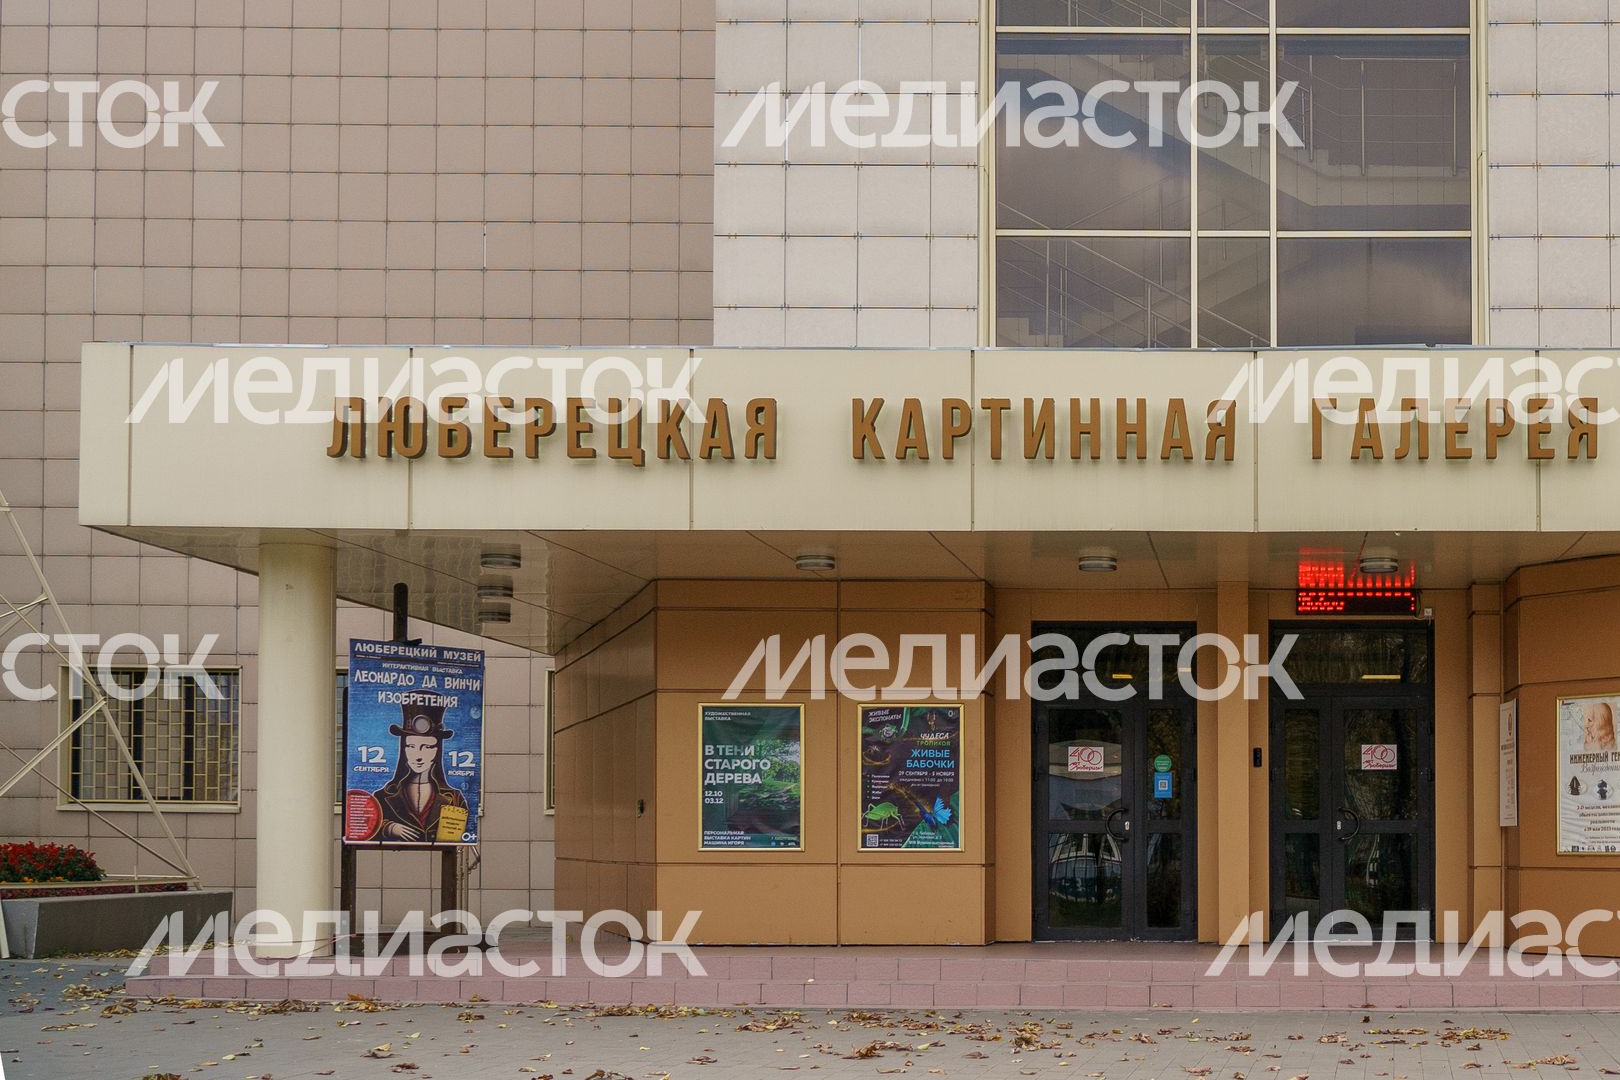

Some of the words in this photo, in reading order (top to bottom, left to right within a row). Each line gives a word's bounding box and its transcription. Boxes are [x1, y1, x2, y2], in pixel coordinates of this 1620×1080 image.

[326, 396, 778, 467] ЛЮБЕРЕЦКАЯ
[851, 397, 1237, 460] КАРТИННАЯ
[1311, 397, 1598, 460] ГАЛЕРЕЯ
[354, 642, 437, 658] ЛЮБЕРЕЦКИЙ
[443, 650, 481, 662] МУЗЕЙ
[354, 669, 415, 686] ЛЕОНАРДО
[421, 675, 438, 688] ДА
[444, 677, 481, 691] ВИНЧИ
[378, 690, 458, 707] ИЗОБРЕТЕНИЯ
[357, 745, 387, 763] 12
[448, 750, 476, 768] 12
[704, 745, 714, 756] В
[911, 749, 951, 758] ЖИВЫЕ
[704, 758, 771, 770] СТАРОГО
[906, 759, 955, 768] БАБОЧКИ
[704, 773, 762, 786] ДЕРЕВА
